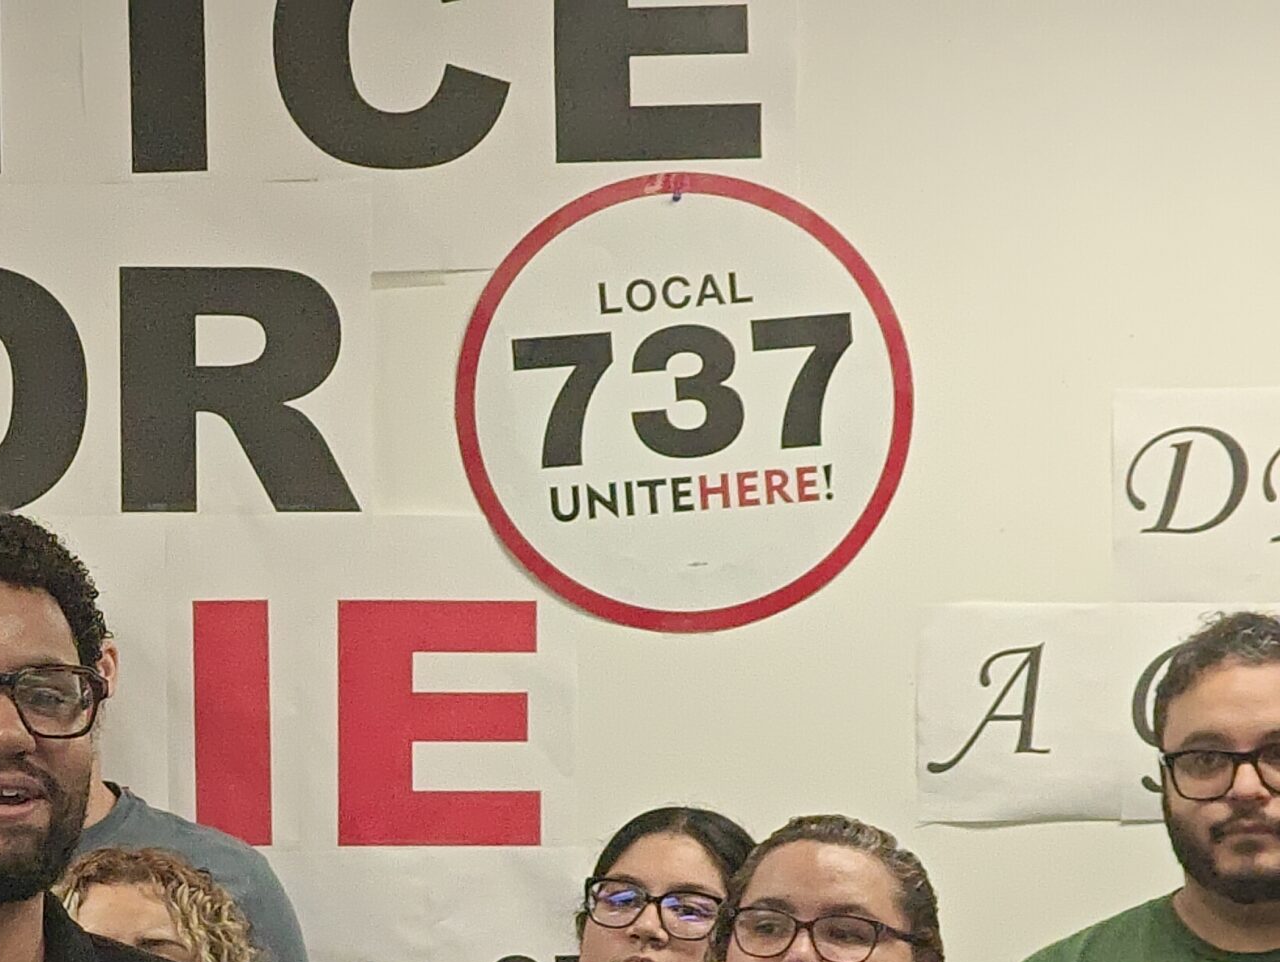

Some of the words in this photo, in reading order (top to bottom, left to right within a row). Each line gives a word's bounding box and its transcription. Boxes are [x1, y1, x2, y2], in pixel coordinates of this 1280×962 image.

[598, 272, 753, 314] LOCAL
[511, 312, 853, 469] 737
[550, 464, 834, 522] UNITEHERE!
[926, 642, 1051, 774] A
